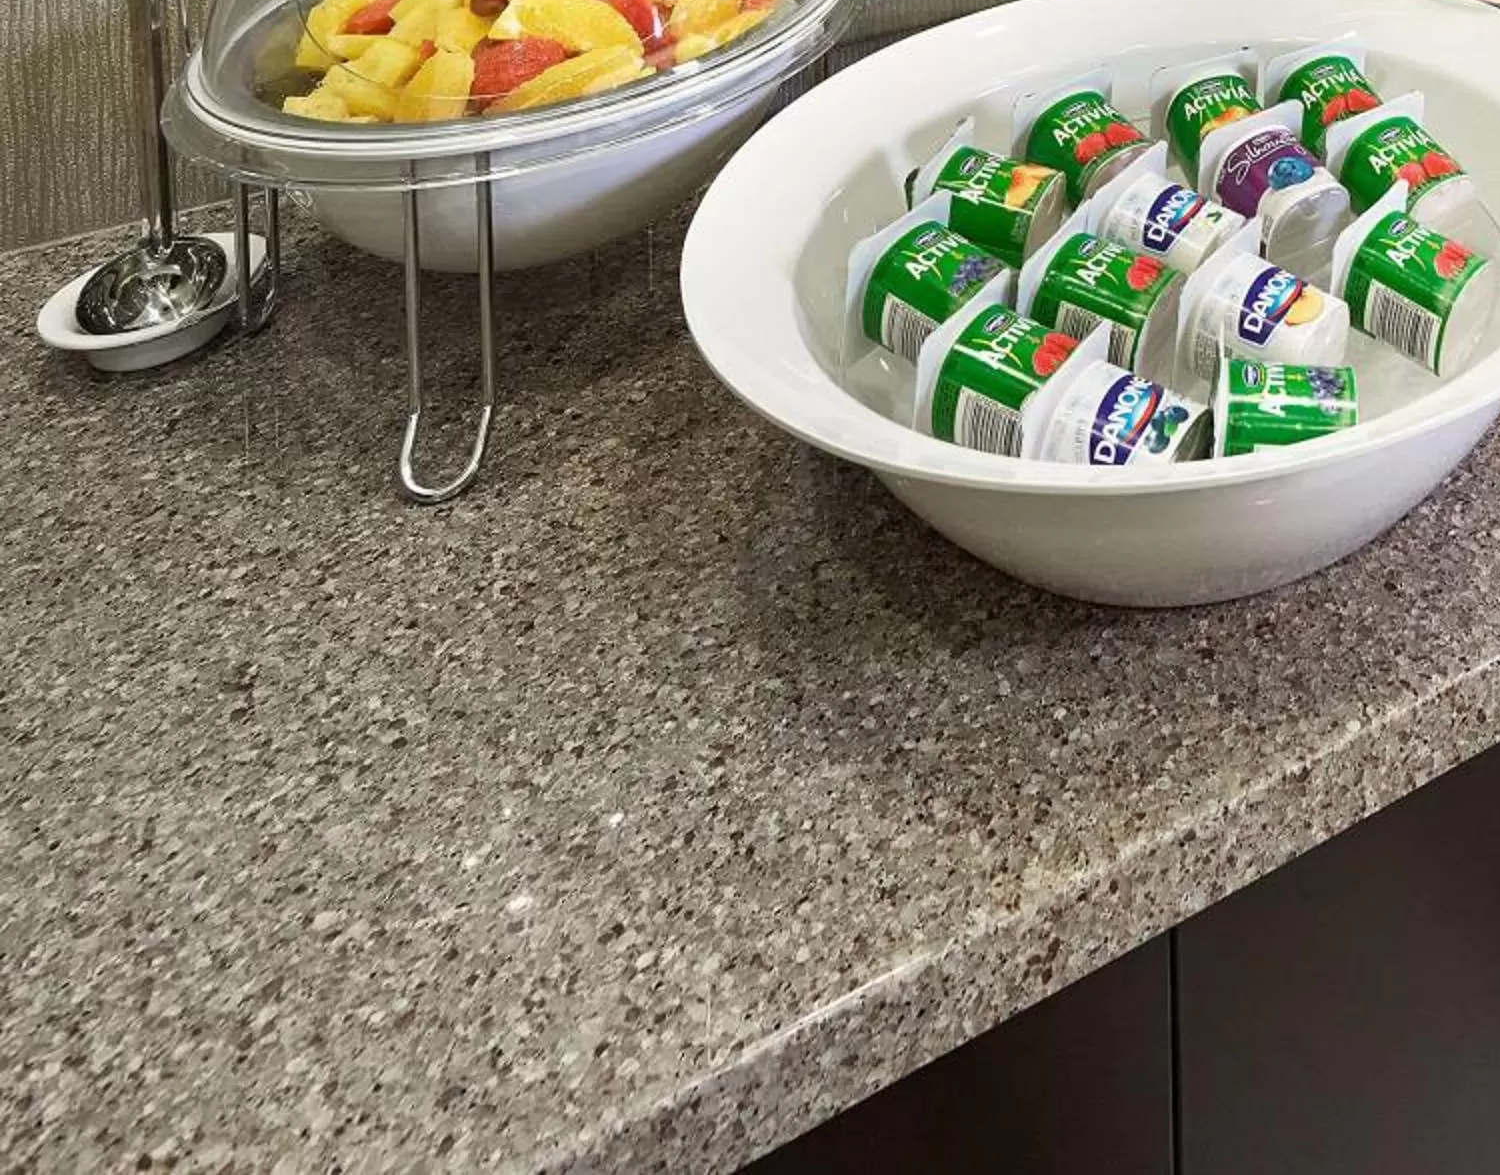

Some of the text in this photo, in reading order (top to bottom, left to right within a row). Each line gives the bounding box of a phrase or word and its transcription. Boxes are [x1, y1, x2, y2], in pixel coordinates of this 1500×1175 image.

[960, 152, 1005, 205] ACTIV
[1147, 189, 1197, 242] DANO
[1076, 243, 1127, 285] ACTIV
[1386, 225, 1430, 268] ACTIV
[1243, 271, 1296, 334] DANO
[1259, 362, 1286, 418] ACTIV
